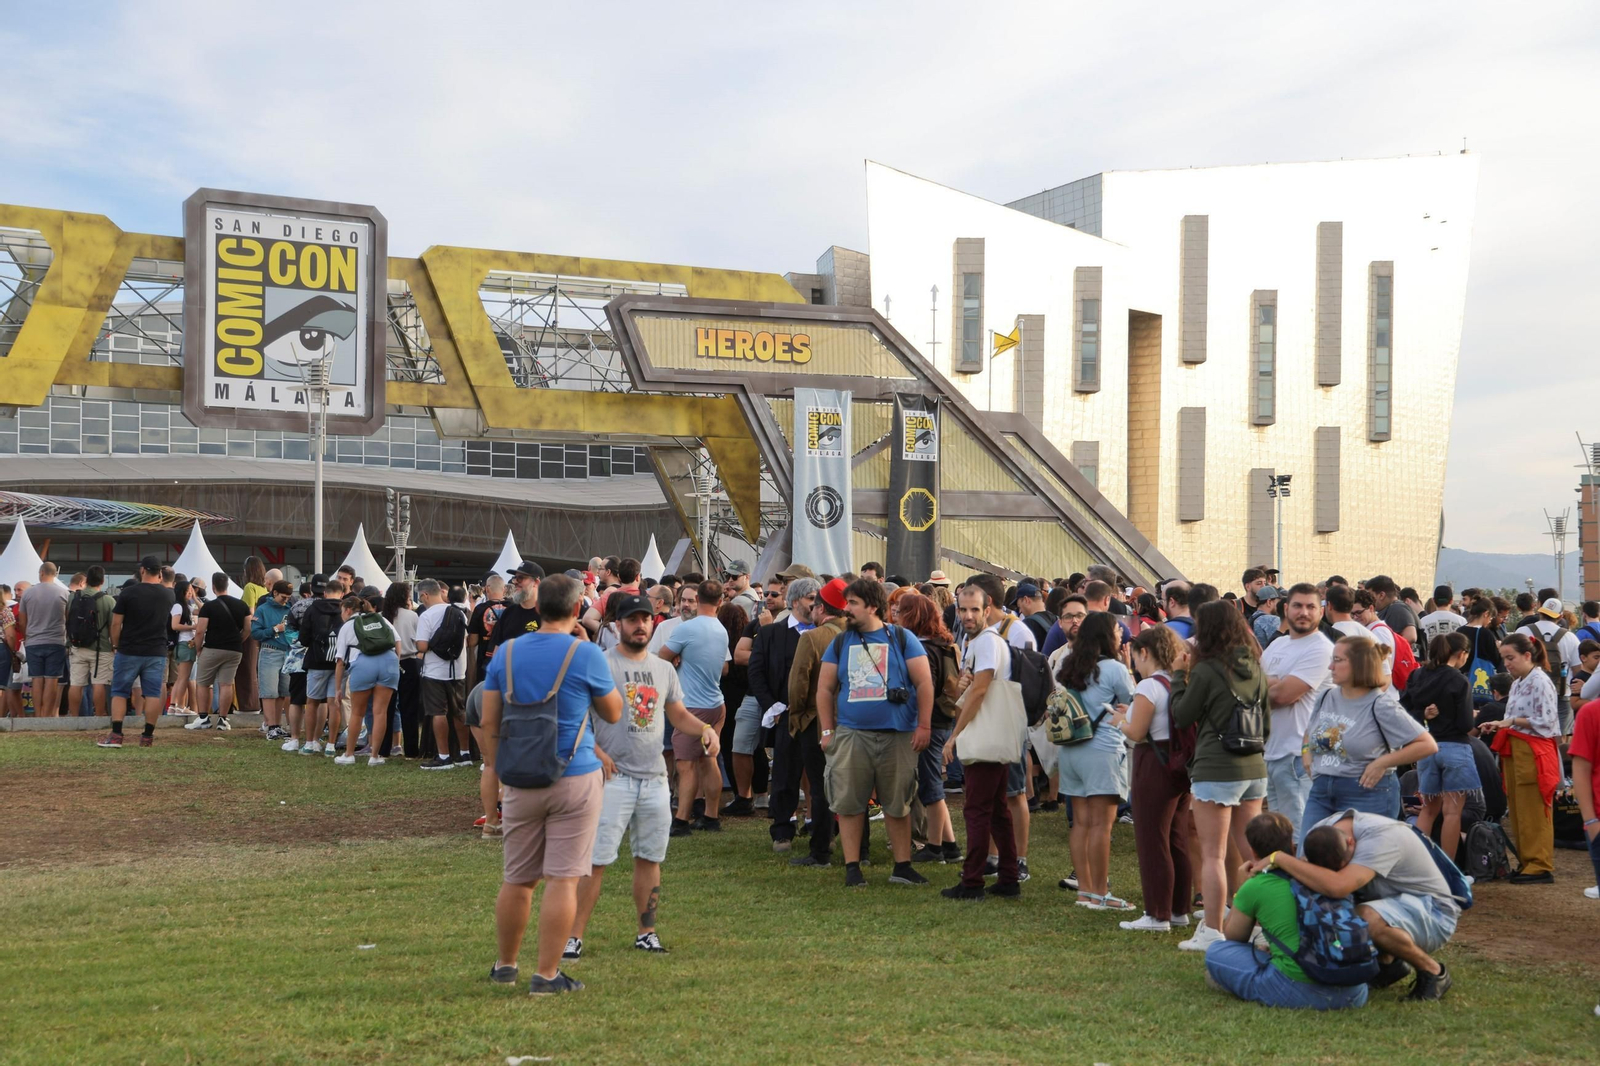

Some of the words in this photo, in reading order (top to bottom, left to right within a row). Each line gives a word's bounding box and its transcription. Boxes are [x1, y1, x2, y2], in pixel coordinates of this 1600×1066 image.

[215, 217, 261, 235] SAN
[283, 224, 359, 244] DIEGO
[268, 241, 356, 292] CON
[216, 237, 265, 377] COMIC
[696, 327, 812, 363] HEROES
[808, 412, 819, 449] COMIC
[820, 412, 841, 426] CON
[905, 416, 917, 453] COMIC
[625, 671, 631, 682] I
[633, 671, 654, 686] AM
[1320, 754, 1340, 767] BOYS
